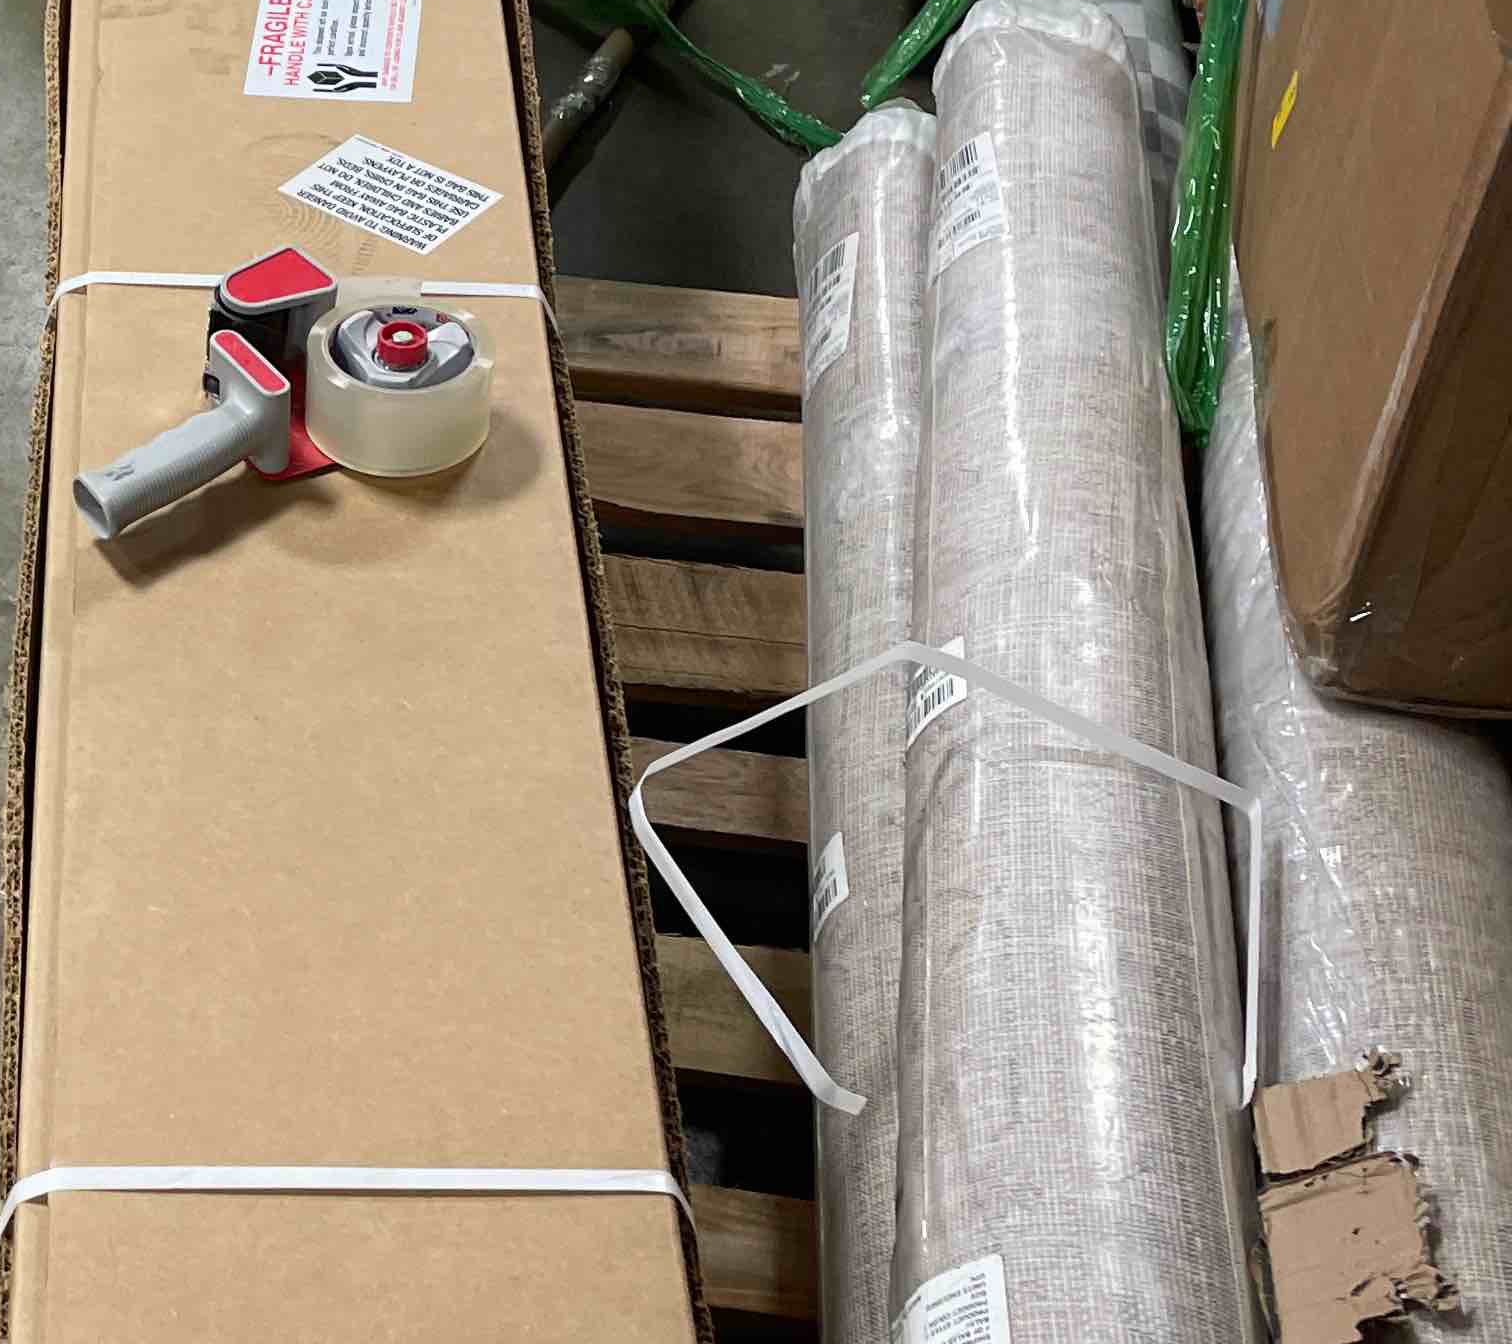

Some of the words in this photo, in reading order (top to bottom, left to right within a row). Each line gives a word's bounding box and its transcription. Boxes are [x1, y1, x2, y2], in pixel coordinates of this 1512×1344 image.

[290, 11, 310, 38] WITH
[283, 39, 306, 86] HANDLE
[442, 179, 469, 193] BAG
